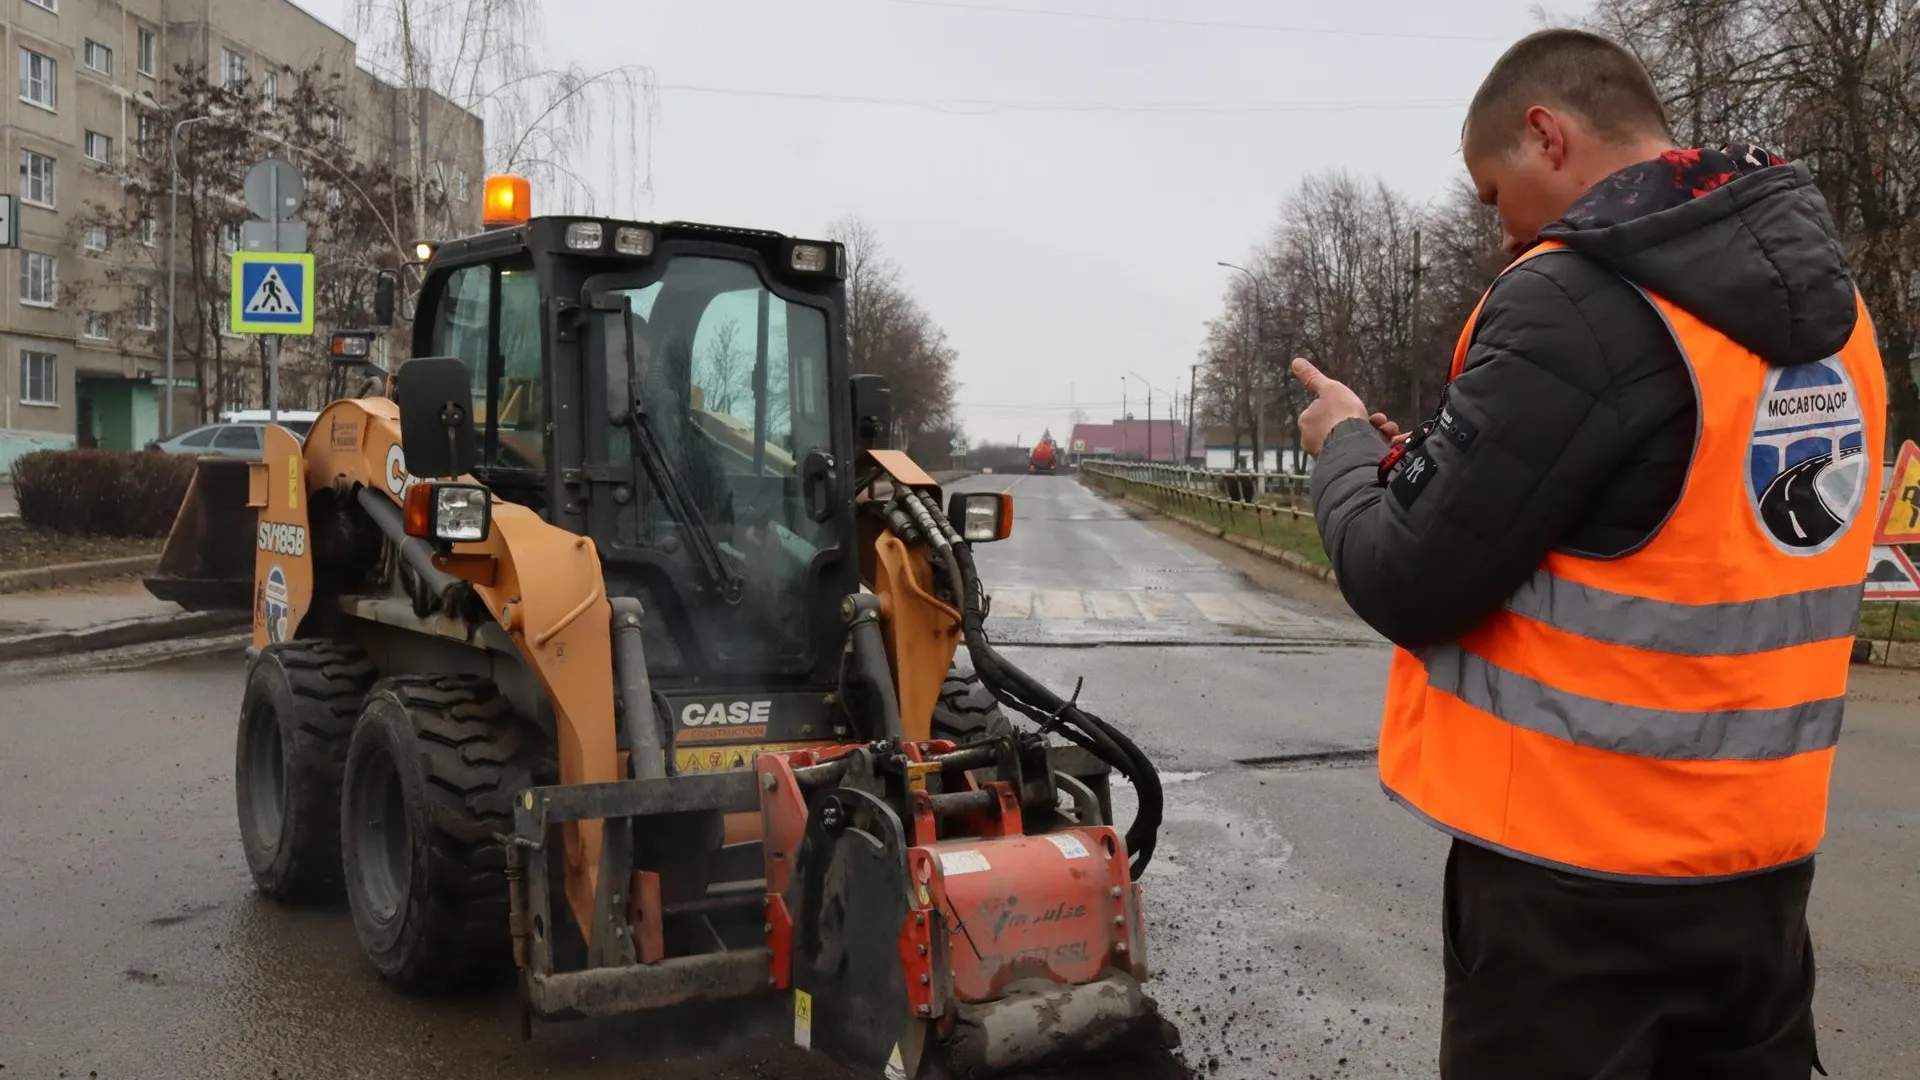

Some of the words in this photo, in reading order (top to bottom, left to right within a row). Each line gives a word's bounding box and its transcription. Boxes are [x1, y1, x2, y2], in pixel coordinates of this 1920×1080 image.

[1768, 392, 1847, 417] МОСАВТОДОР
[258, 521, 305, 557] SV185B
[681, 701, 771, 726] CASE
